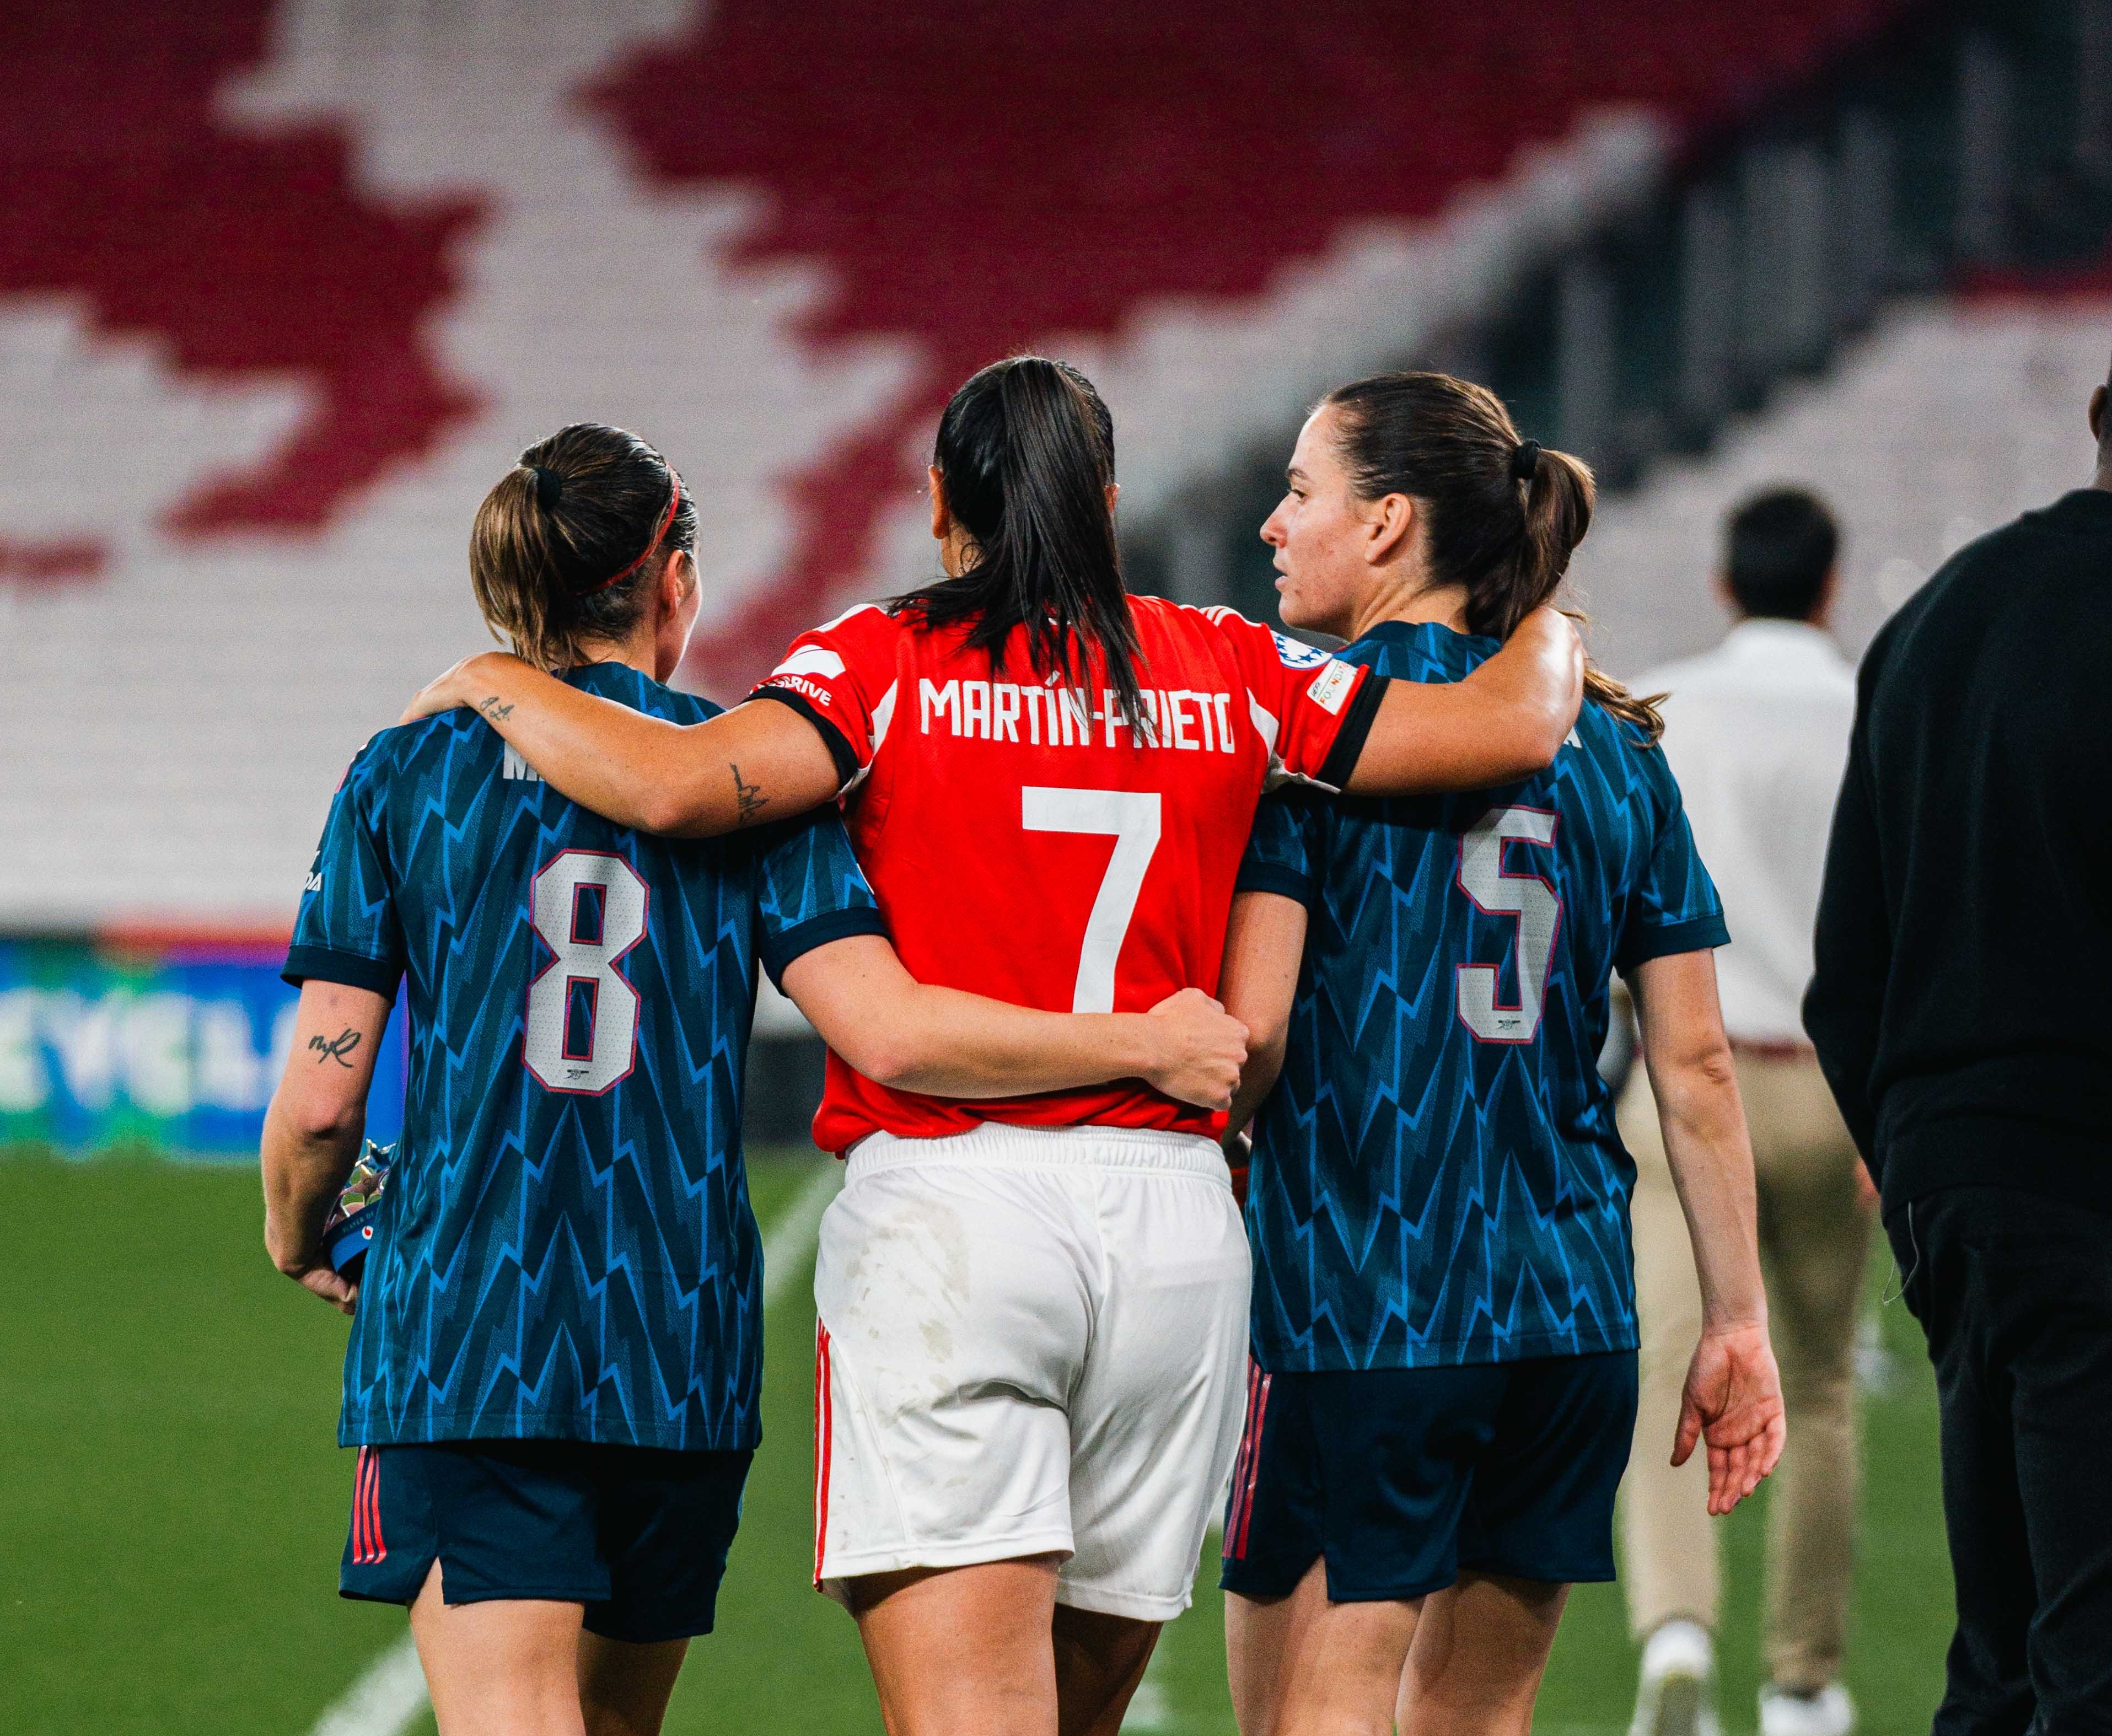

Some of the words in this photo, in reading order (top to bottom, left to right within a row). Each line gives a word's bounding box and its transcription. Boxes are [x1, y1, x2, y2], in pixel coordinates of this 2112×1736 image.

[919, 670, 1235, 754] MARTÍN-PRIETO
[520, 848, 650, 1097] 8
[1022, 786, 1161, 1014] 7
[1456, 804, 1563, 1044] 5
